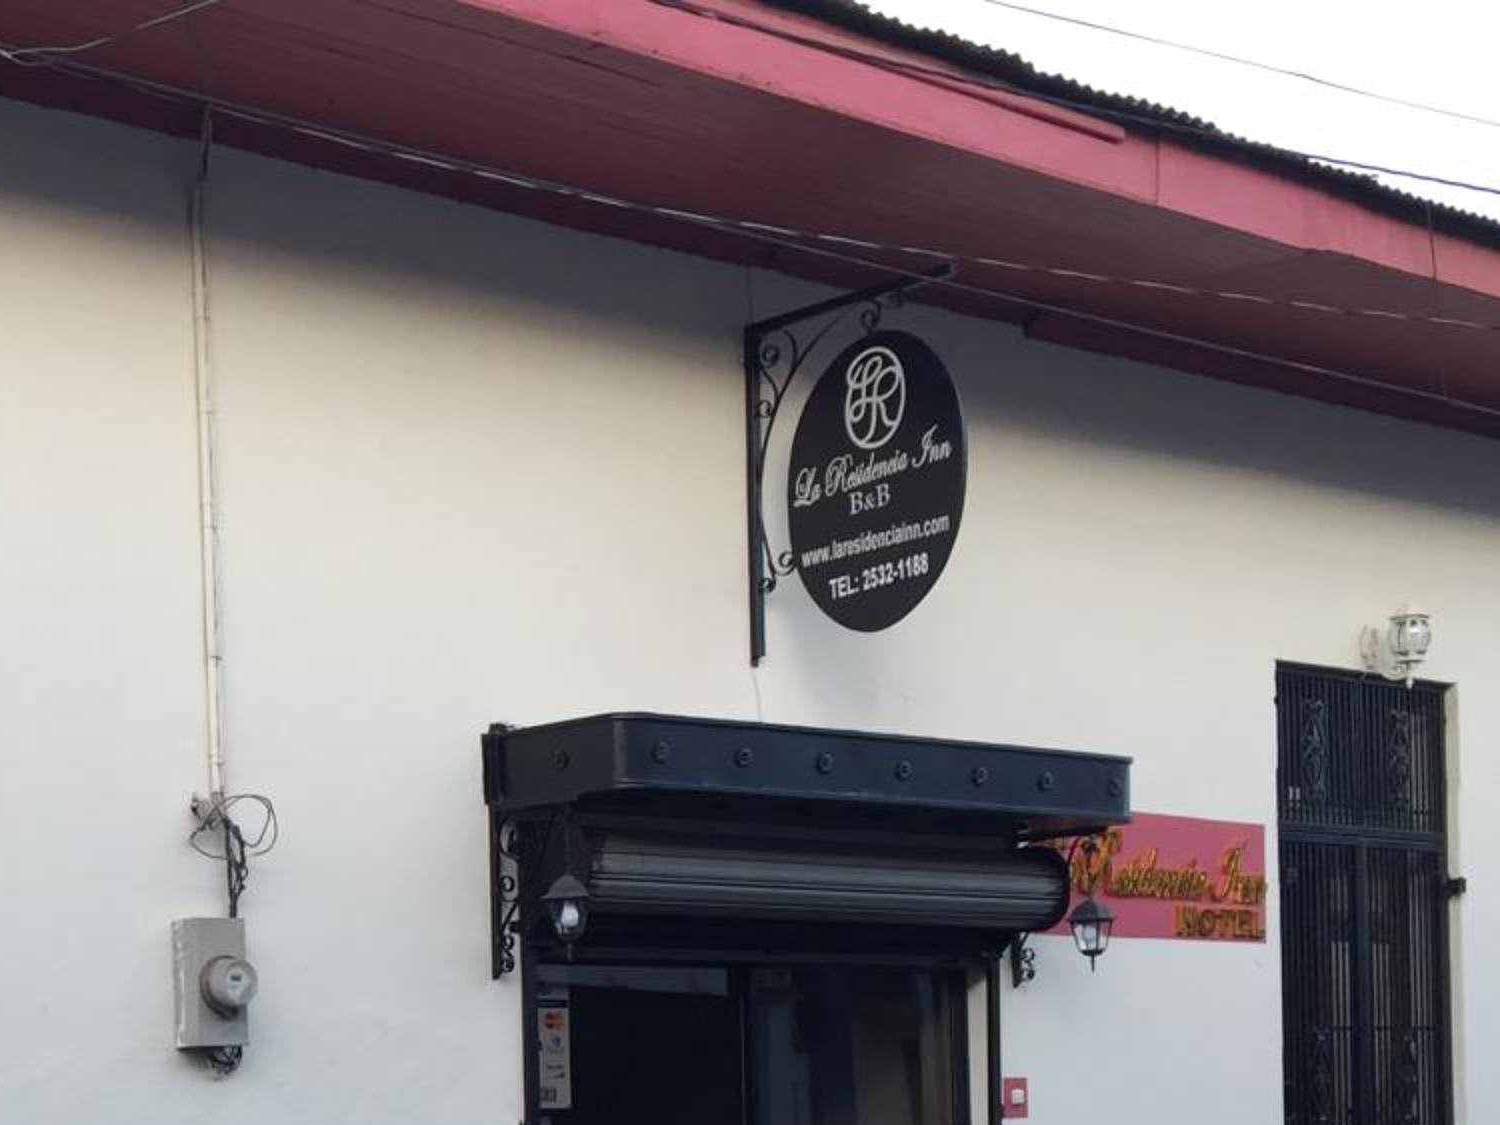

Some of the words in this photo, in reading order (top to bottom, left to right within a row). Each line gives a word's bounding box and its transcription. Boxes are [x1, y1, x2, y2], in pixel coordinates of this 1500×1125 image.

[793, 467, 821, 508] La
[825, 453, 908, 496] Residencia
[911, 424, 952, 468] Inn
[848, 483, 891, 515] B&B
[801, 515, 950, 568] www.laresidenciainn.com
[828, 575, 859, 600] TEL:
[862, 552, 929, 590] 2532-1188
